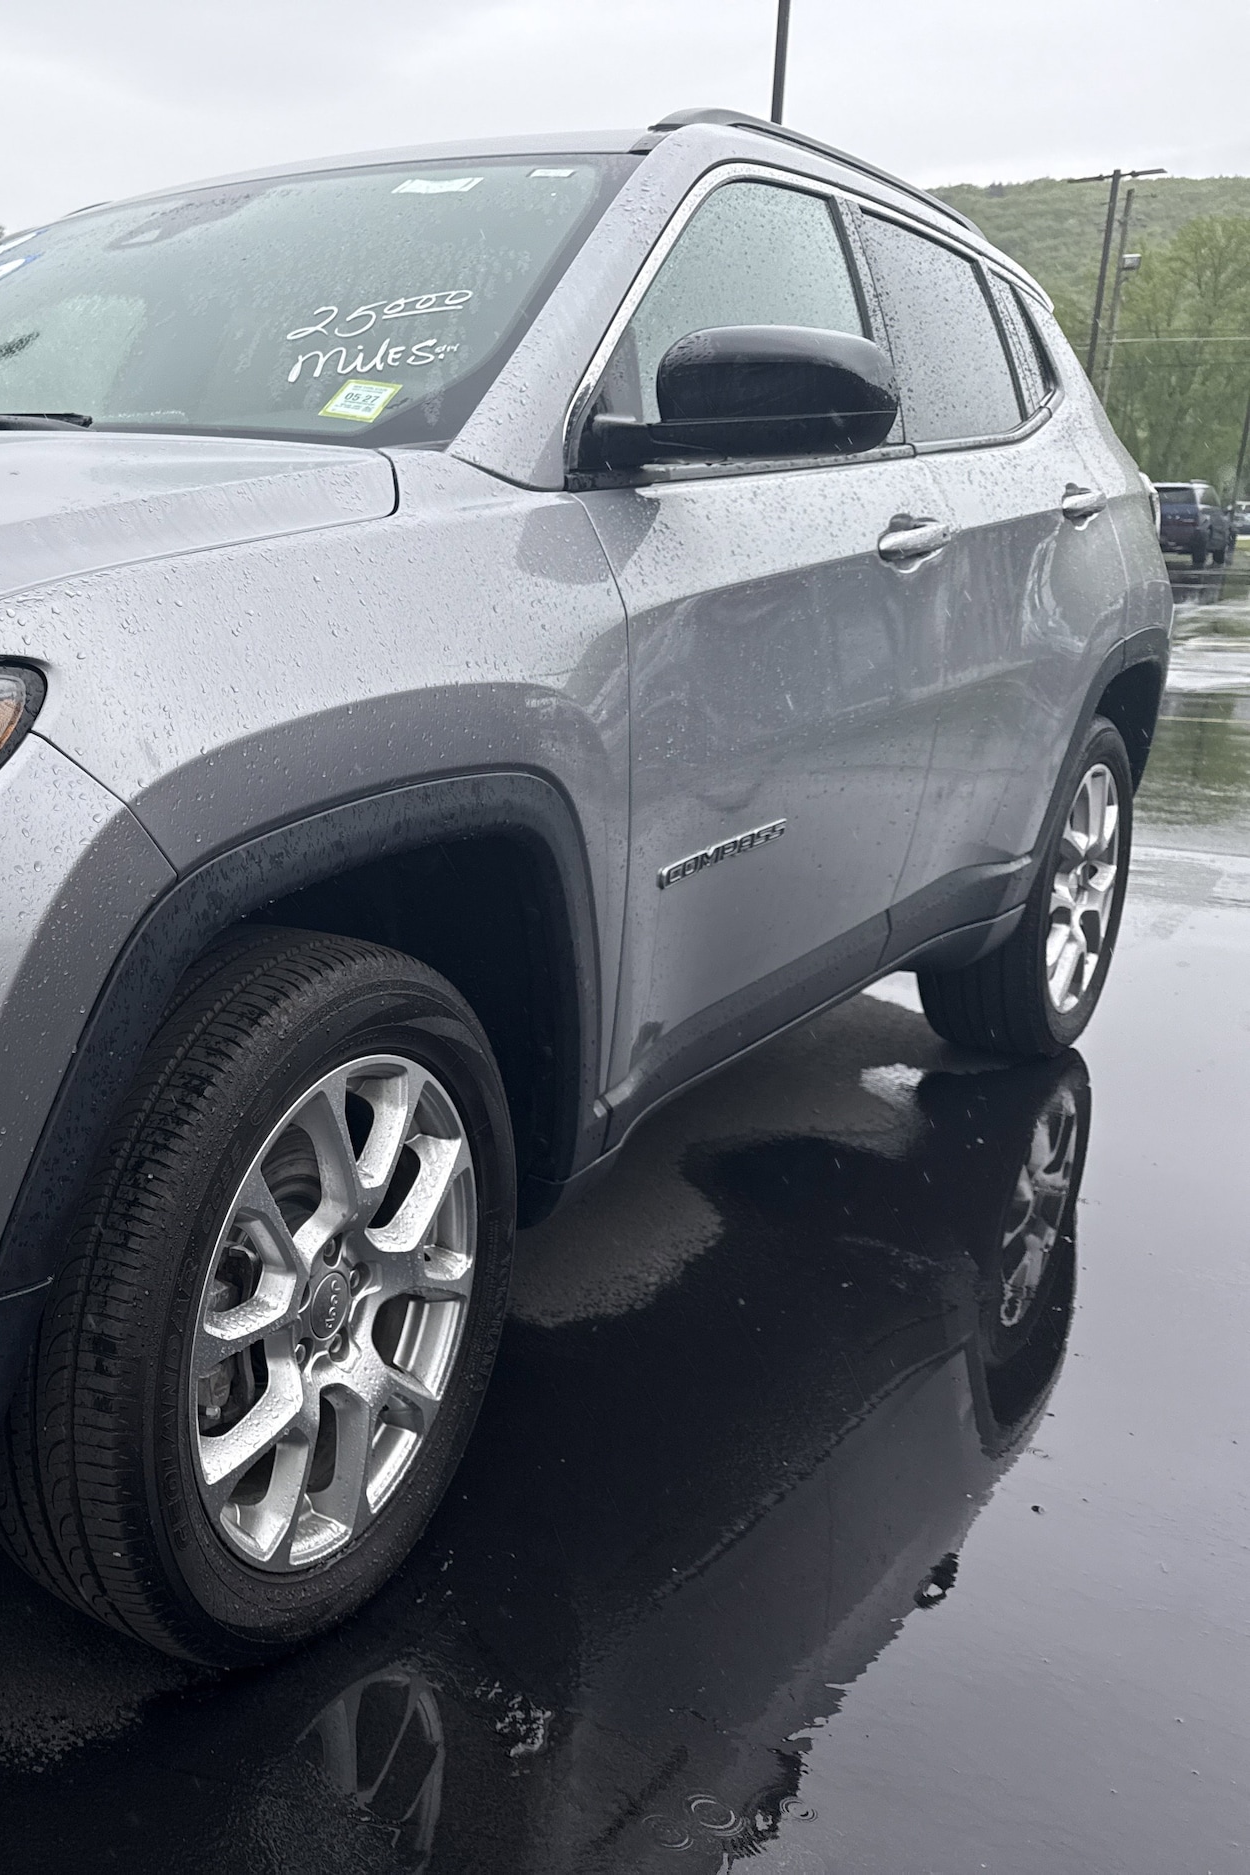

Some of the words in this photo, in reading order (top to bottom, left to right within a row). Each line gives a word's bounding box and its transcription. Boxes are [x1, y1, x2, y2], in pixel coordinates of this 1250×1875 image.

[344, 392, 362, 402] 05
[362, 395, 380, 404] 27
[656, 818, 787, 890] COMPASS
